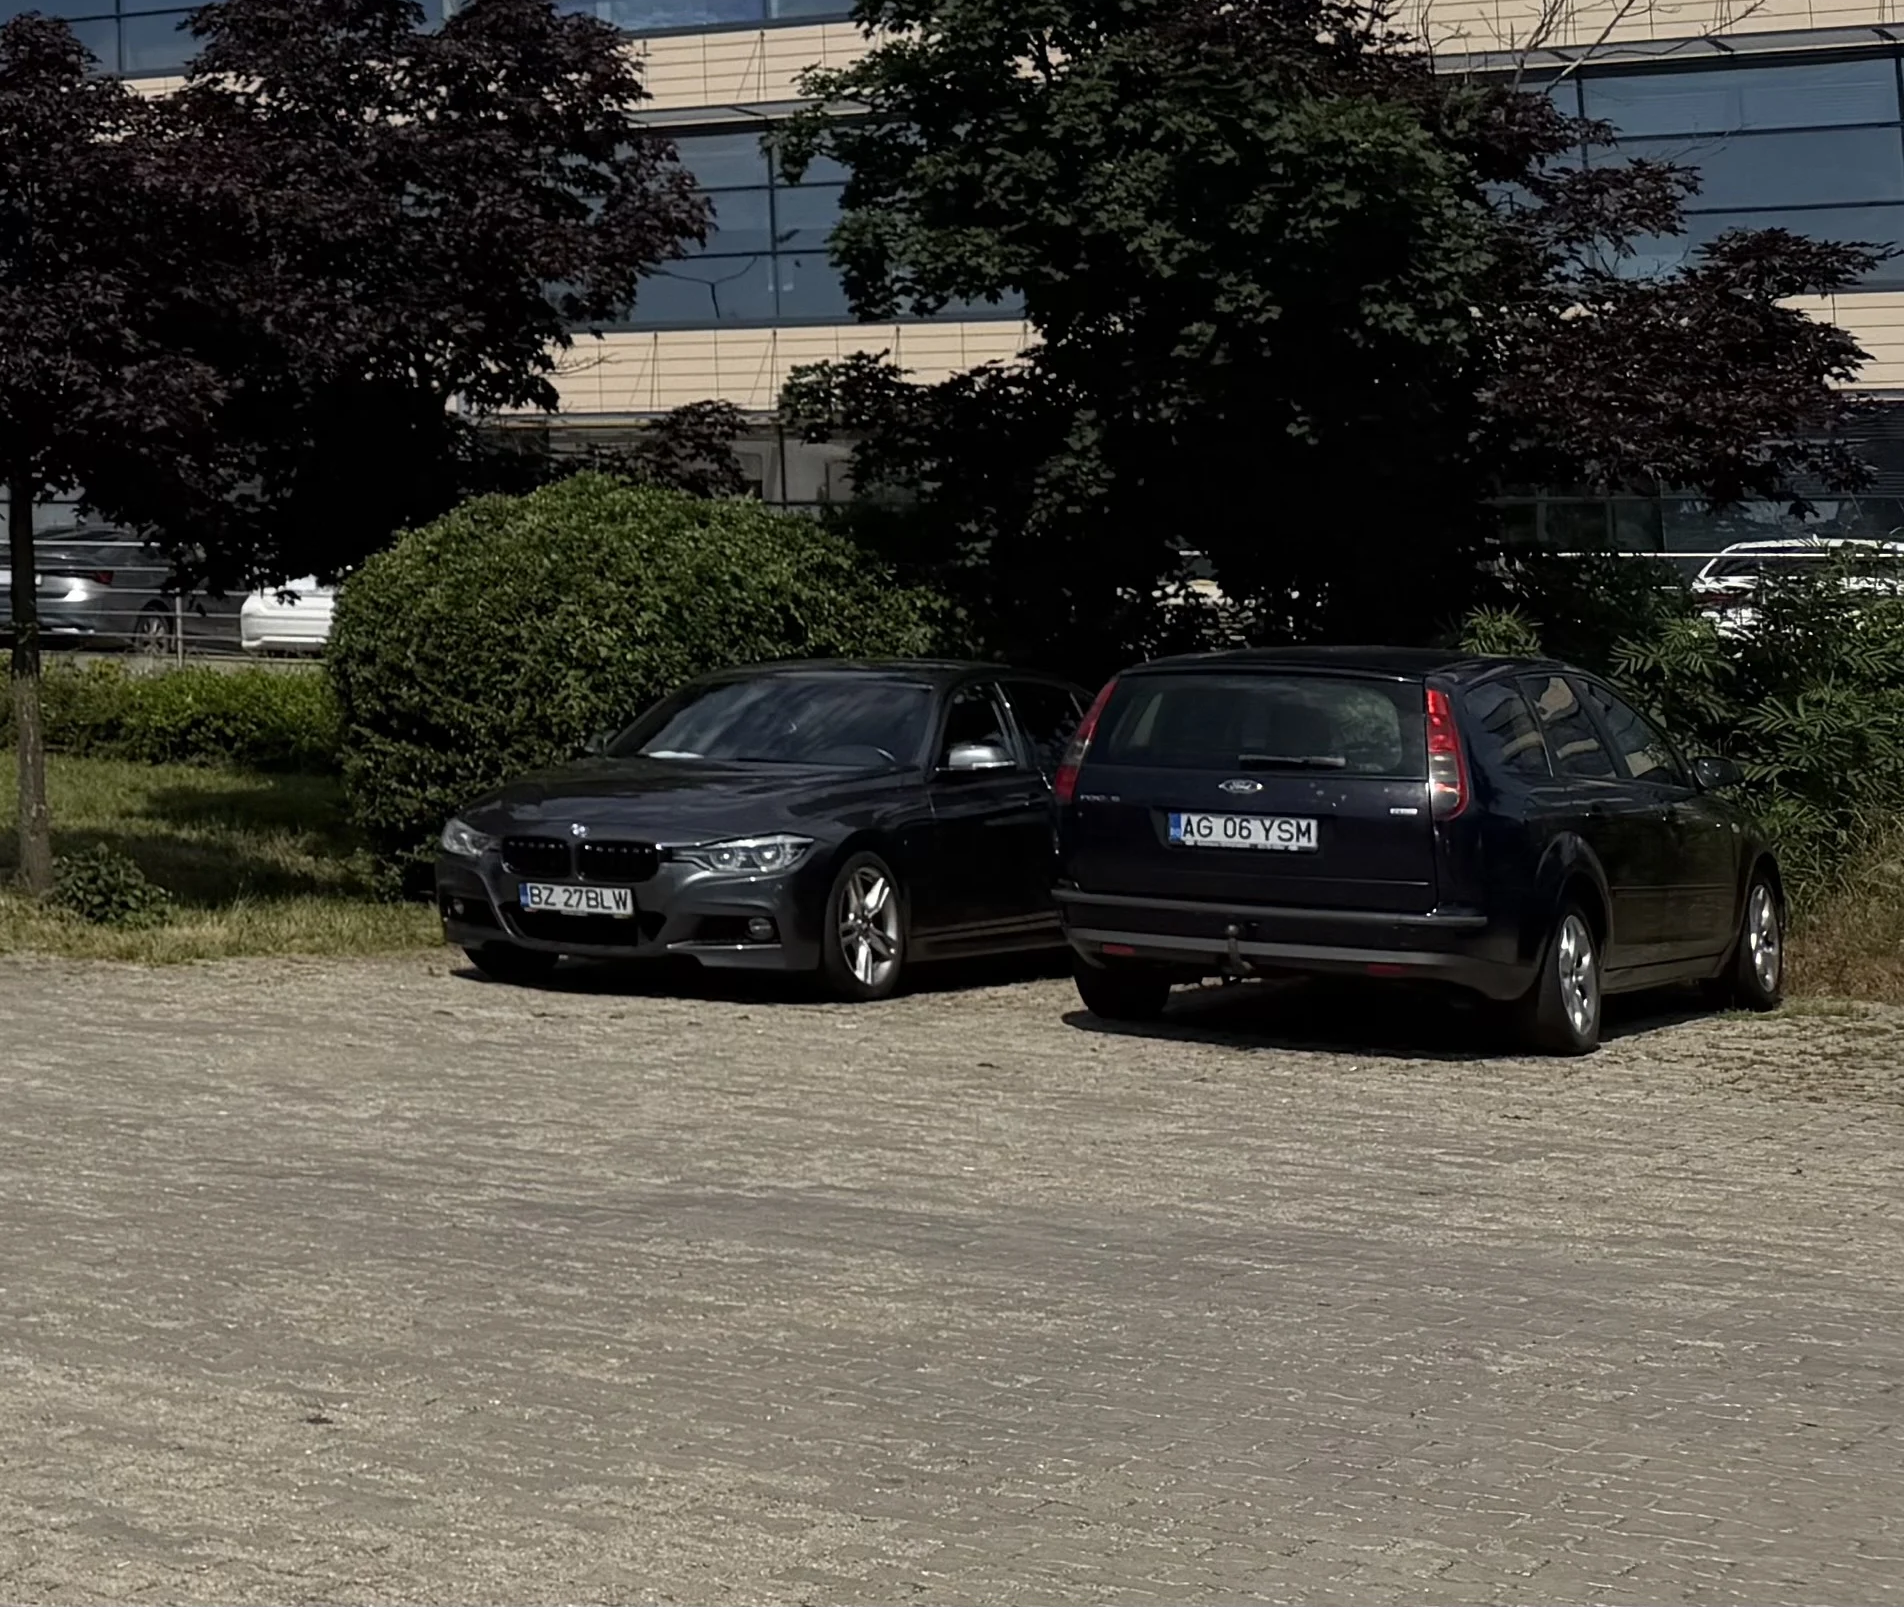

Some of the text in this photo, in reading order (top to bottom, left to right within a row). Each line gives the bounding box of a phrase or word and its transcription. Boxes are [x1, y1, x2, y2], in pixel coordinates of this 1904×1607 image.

[1182, 816, 1312, 843] AG 06 YSM
[529, 885, 628, 910] BZ 27 BLW
